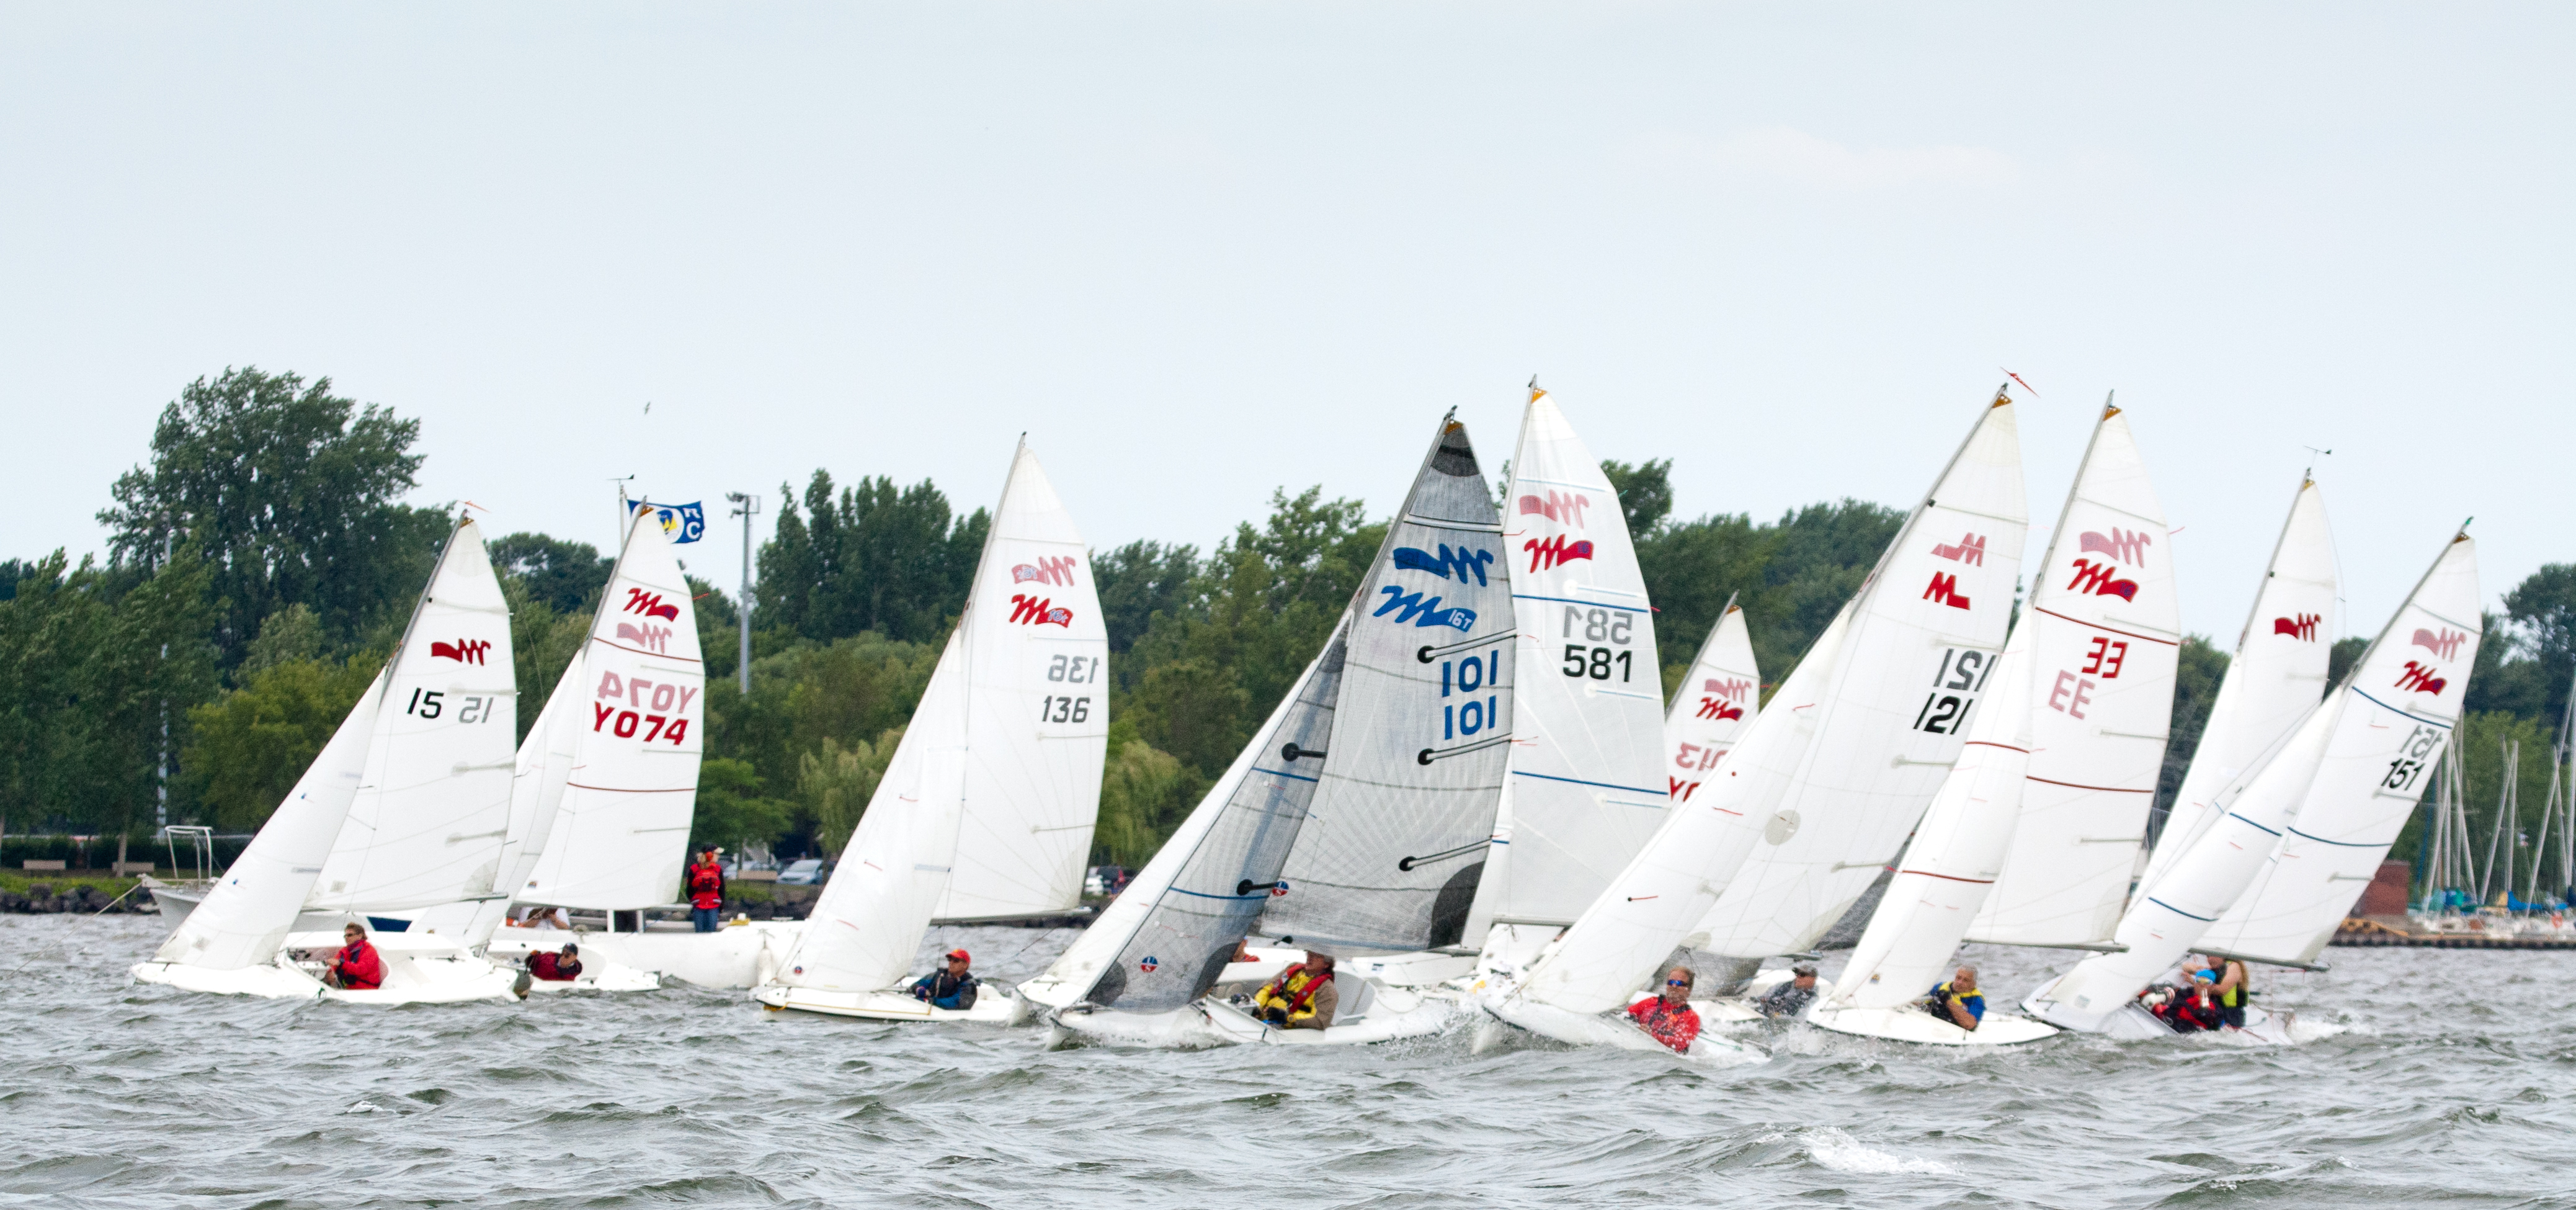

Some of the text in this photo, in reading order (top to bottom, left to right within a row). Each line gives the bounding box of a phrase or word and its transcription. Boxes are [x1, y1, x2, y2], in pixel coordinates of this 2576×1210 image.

[687, 522, 701, 539] C
[1442, 650, 1499, 697] 101
[1562, 643, 1633, 683] 581
[2081, 636, 2129, 679] 33
[407, 687, 444, 719] 15
[593, 701, 689, 746] Y074
[1042, 695, 1090, 724] 136
[1444, 695, 1497, 740] 101
[1912, 691, 1974, 735] 121
[2380, 758, 2426, 791] 151
